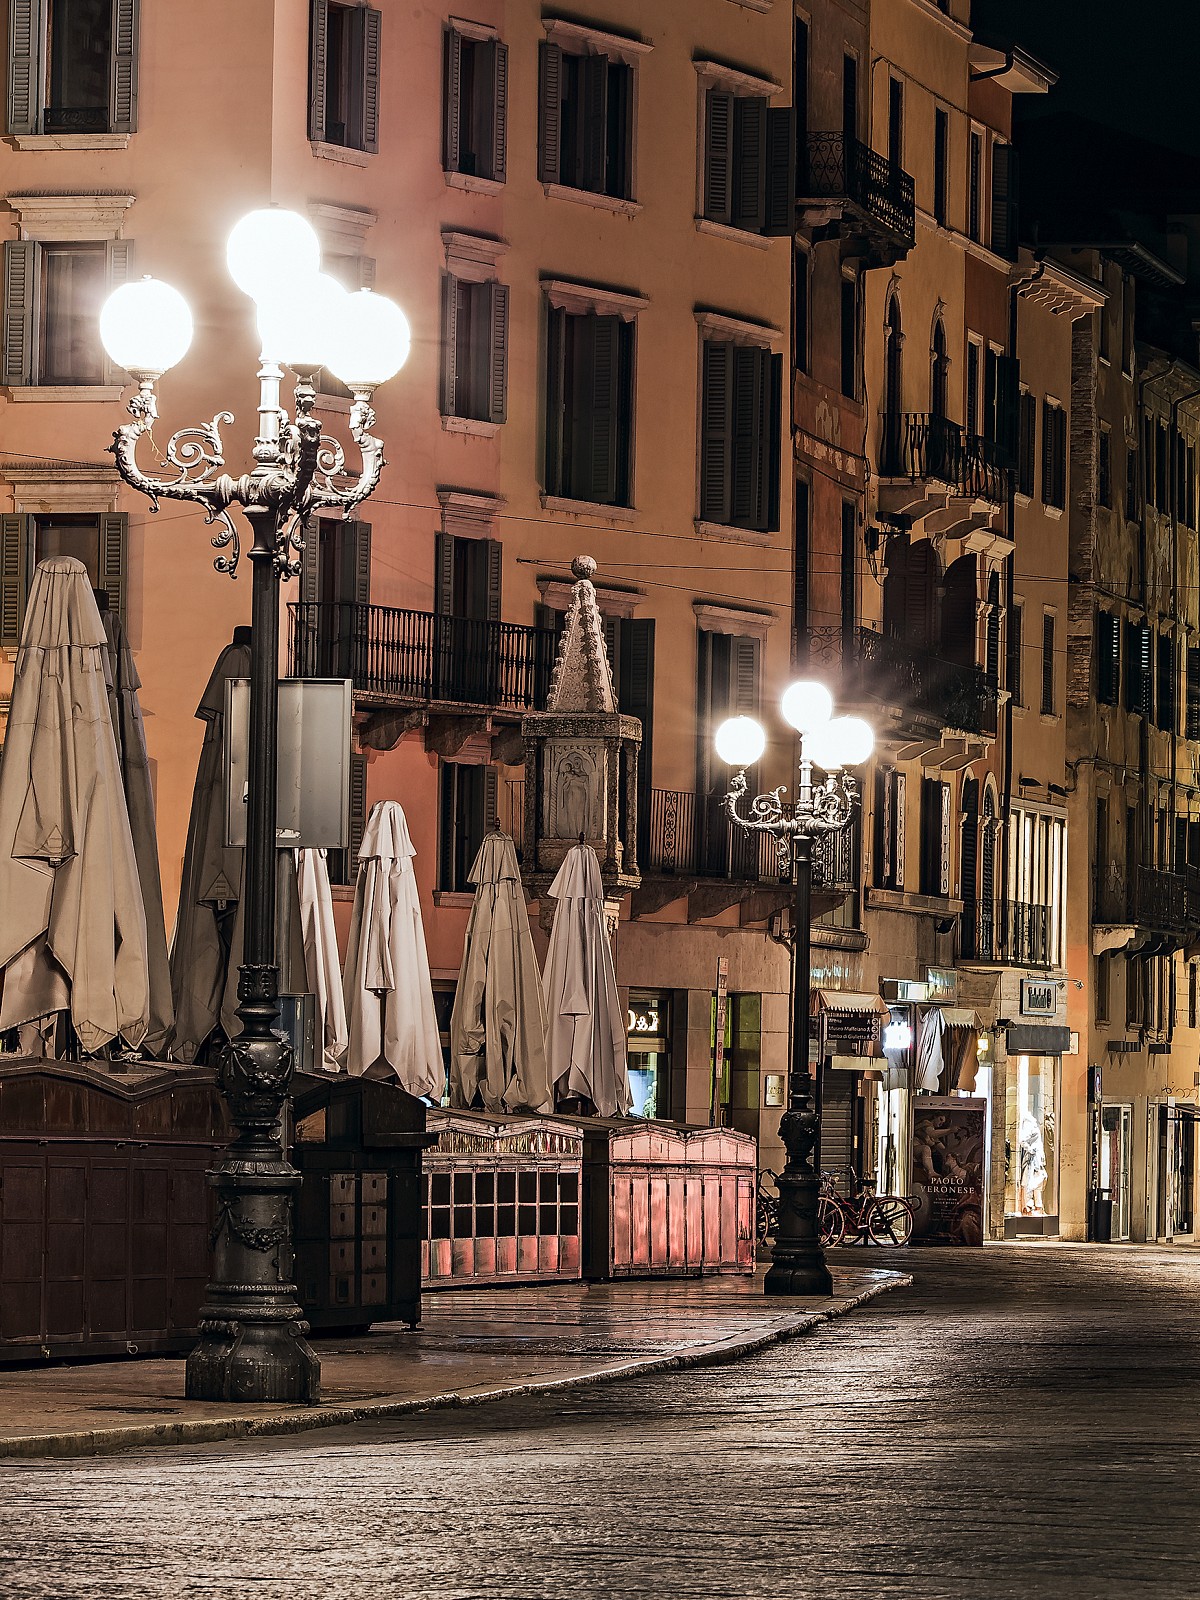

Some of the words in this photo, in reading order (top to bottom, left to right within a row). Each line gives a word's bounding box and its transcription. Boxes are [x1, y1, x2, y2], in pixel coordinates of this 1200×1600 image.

[942, 787, 950, 891] TATTOO
[930, 1176, 964, 1185] PAOLO
[920, 1185, 975, 1194] VERONESE
